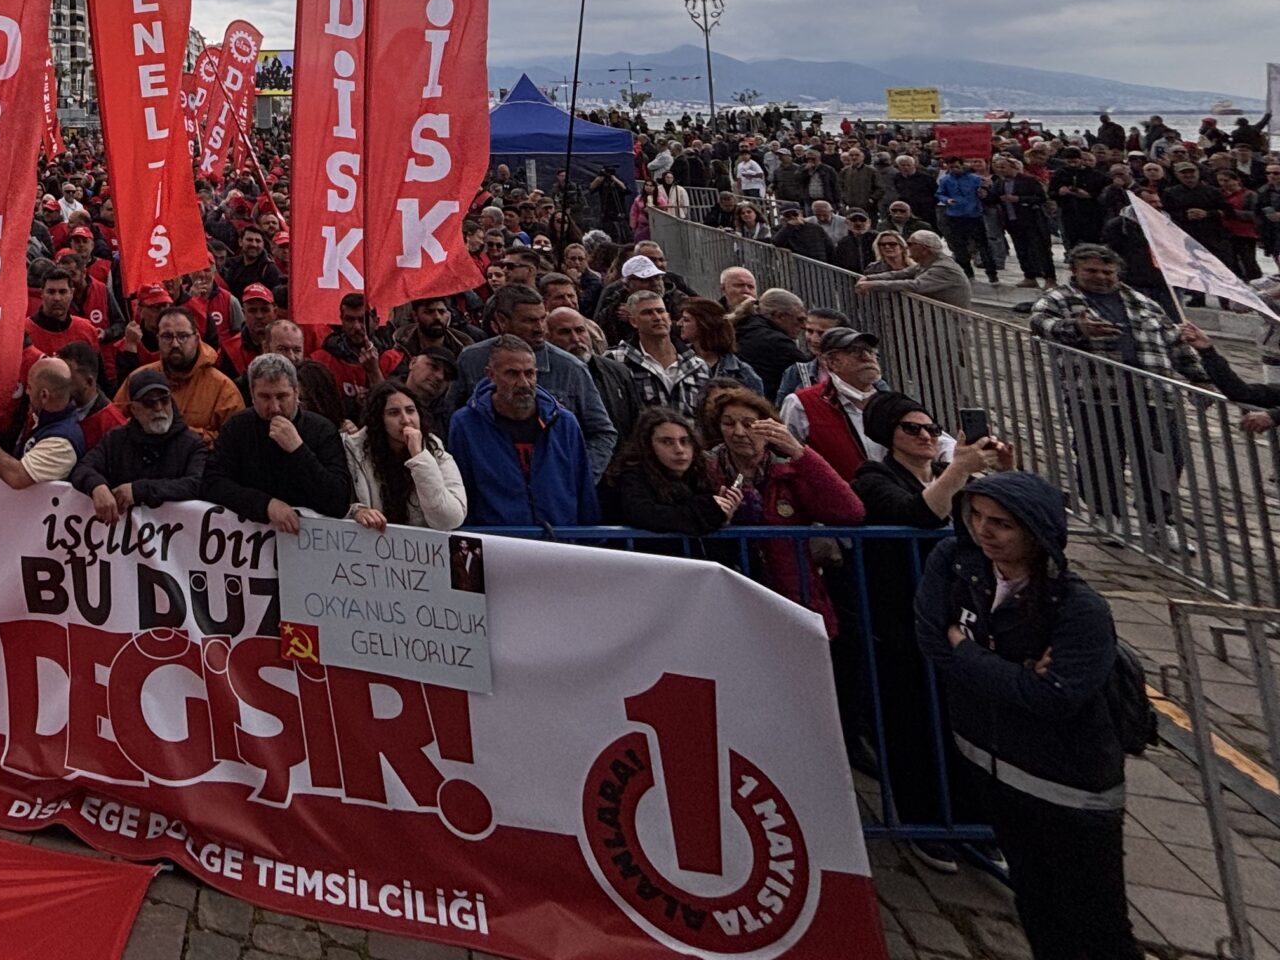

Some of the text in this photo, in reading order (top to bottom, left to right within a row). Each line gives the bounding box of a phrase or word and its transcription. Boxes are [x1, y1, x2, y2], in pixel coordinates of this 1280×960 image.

[42, 496, 278, 570] işçiler bir
[374, 534, 446, 568] OLDUK
[21, 555, 282, 639] BU DÜZ
[331, 562, 430, 593] ASTINIZ
[304, 592, 488, 638] OKYANUS OLDUK
[736, 773, 760, 799] 1
[79, 796, 141, 839] EGE
[252, 854, 490, 936] TEMSİLCİLİĞİ
